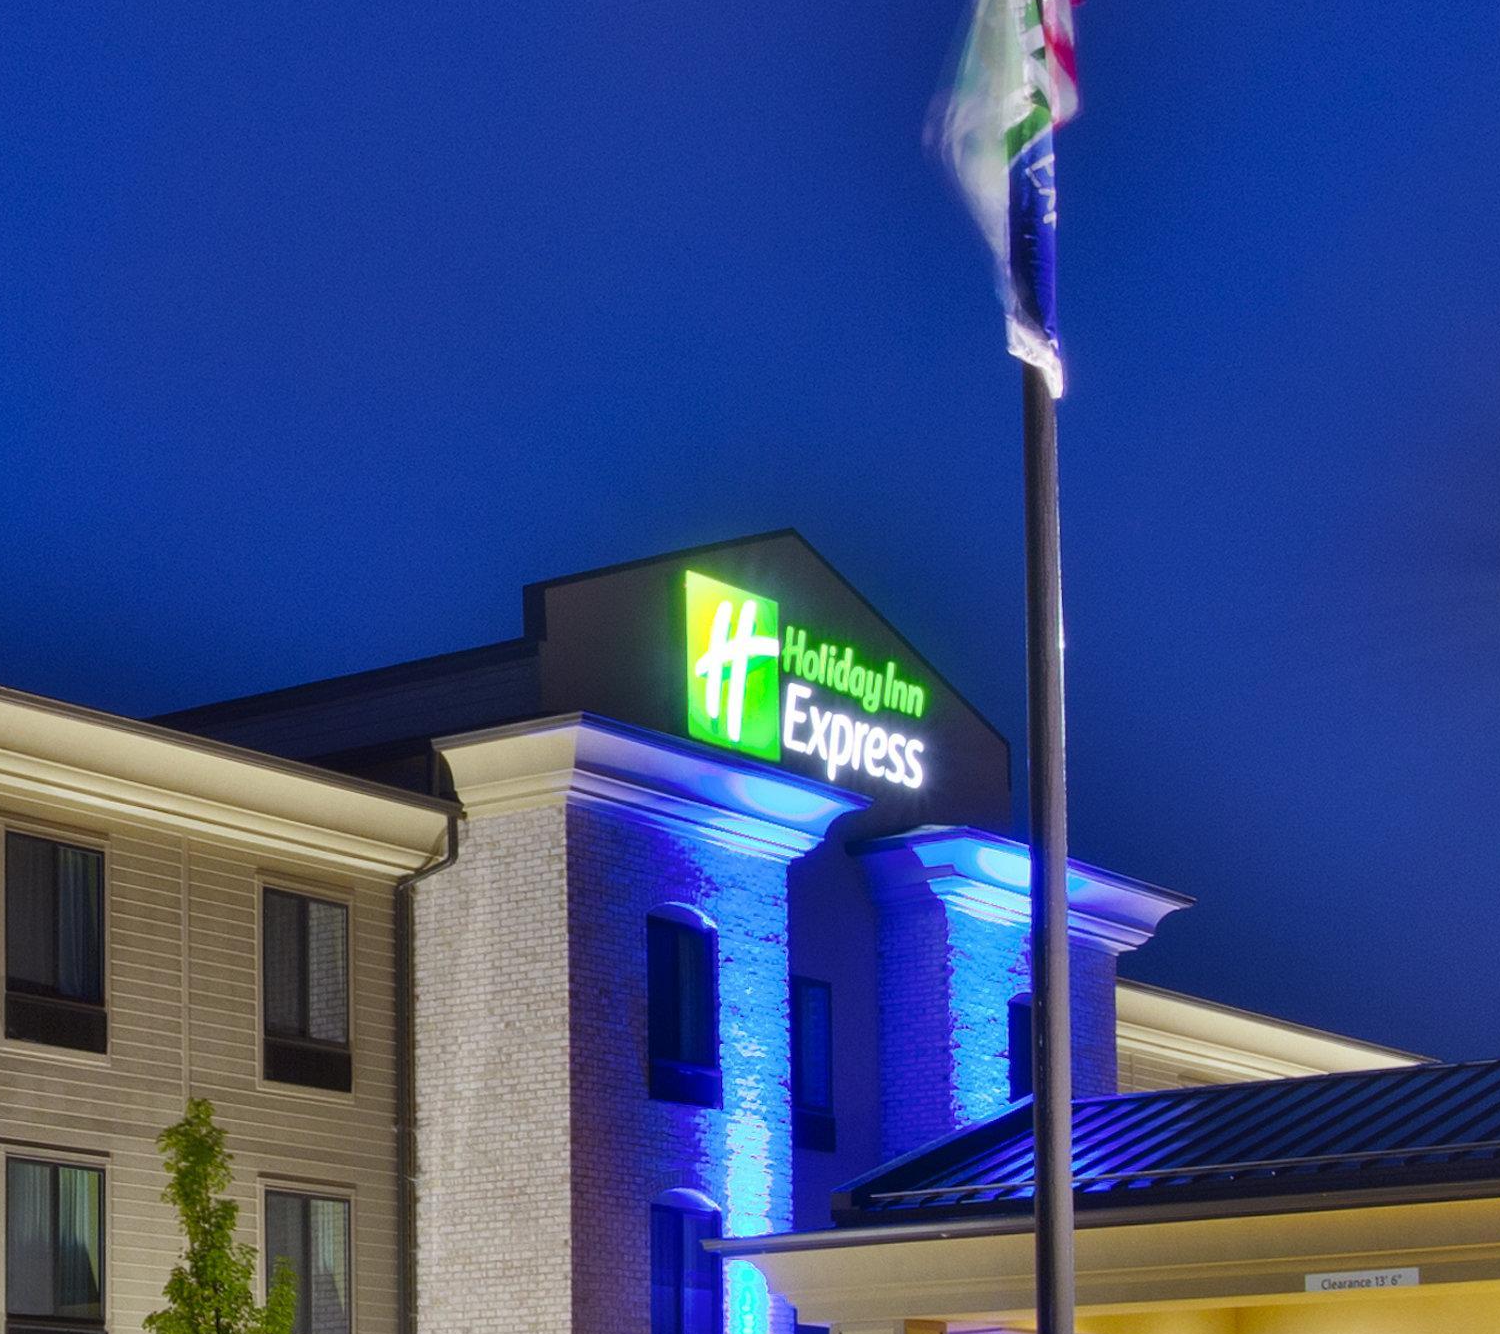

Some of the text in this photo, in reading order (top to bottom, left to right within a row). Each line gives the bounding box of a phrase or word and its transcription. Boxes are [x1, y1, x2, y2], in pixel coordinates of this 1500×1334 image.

[782, 625, 924, 718] Holiday Inn
[782, 682, 925, 790] Express
[1321, 1277, 1372, 1290] Clearance
